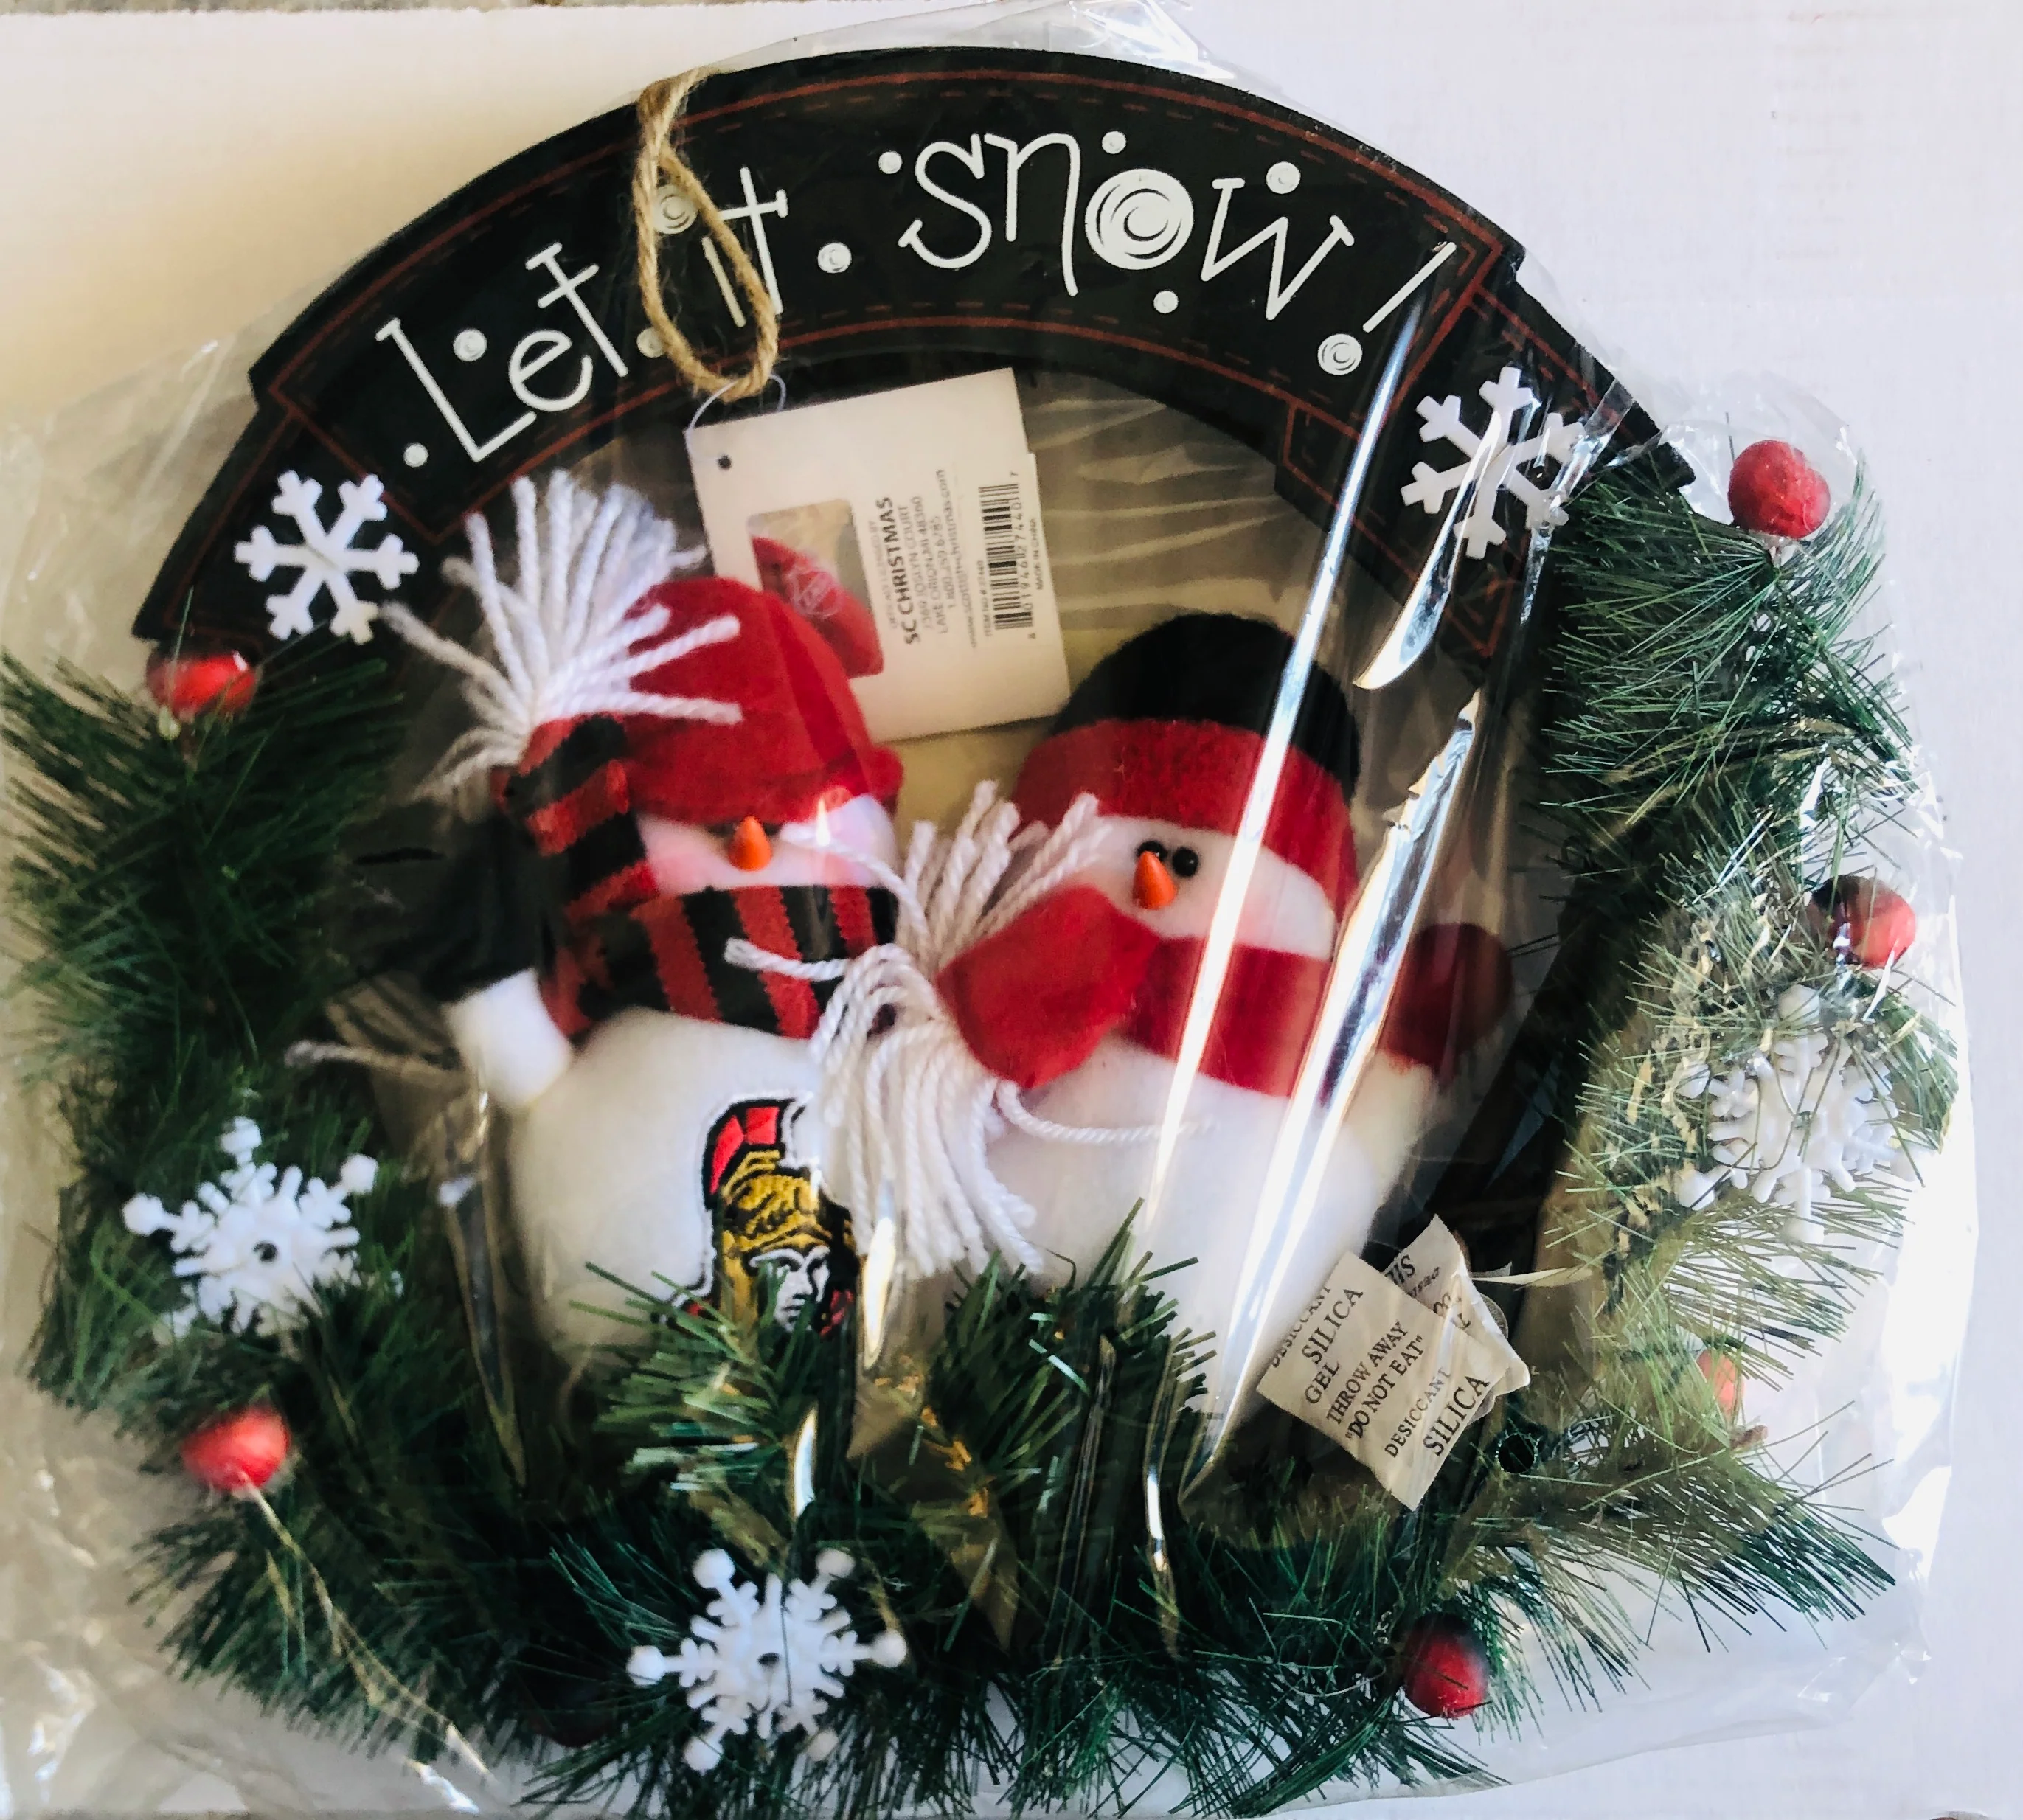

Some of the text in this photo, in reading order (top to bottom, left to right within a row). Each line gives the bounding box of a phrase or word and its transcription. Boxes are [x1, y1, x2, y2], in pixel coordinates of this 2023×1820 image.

[375, 242, 629, 462] Let
[1030, 518, 1039, 547] CHINA
[875, 497, 921, 645] SC CHRISTMAS
[1034, 564, 1044, 590] MADE
[932, 603, 948, 634] LAKE
[1302, 1288, 1364, 1364] SILICA
[1305, 1361, 1340, 1404] GEL
[1327, 1321, 1408, 1425] THROW AWAY
[1362, 1373, 1395, 1414] NOT
[1384, 1367, 1451, 1458] DESICCANT
[1423, 1373, 1490, 1457] SILICA
